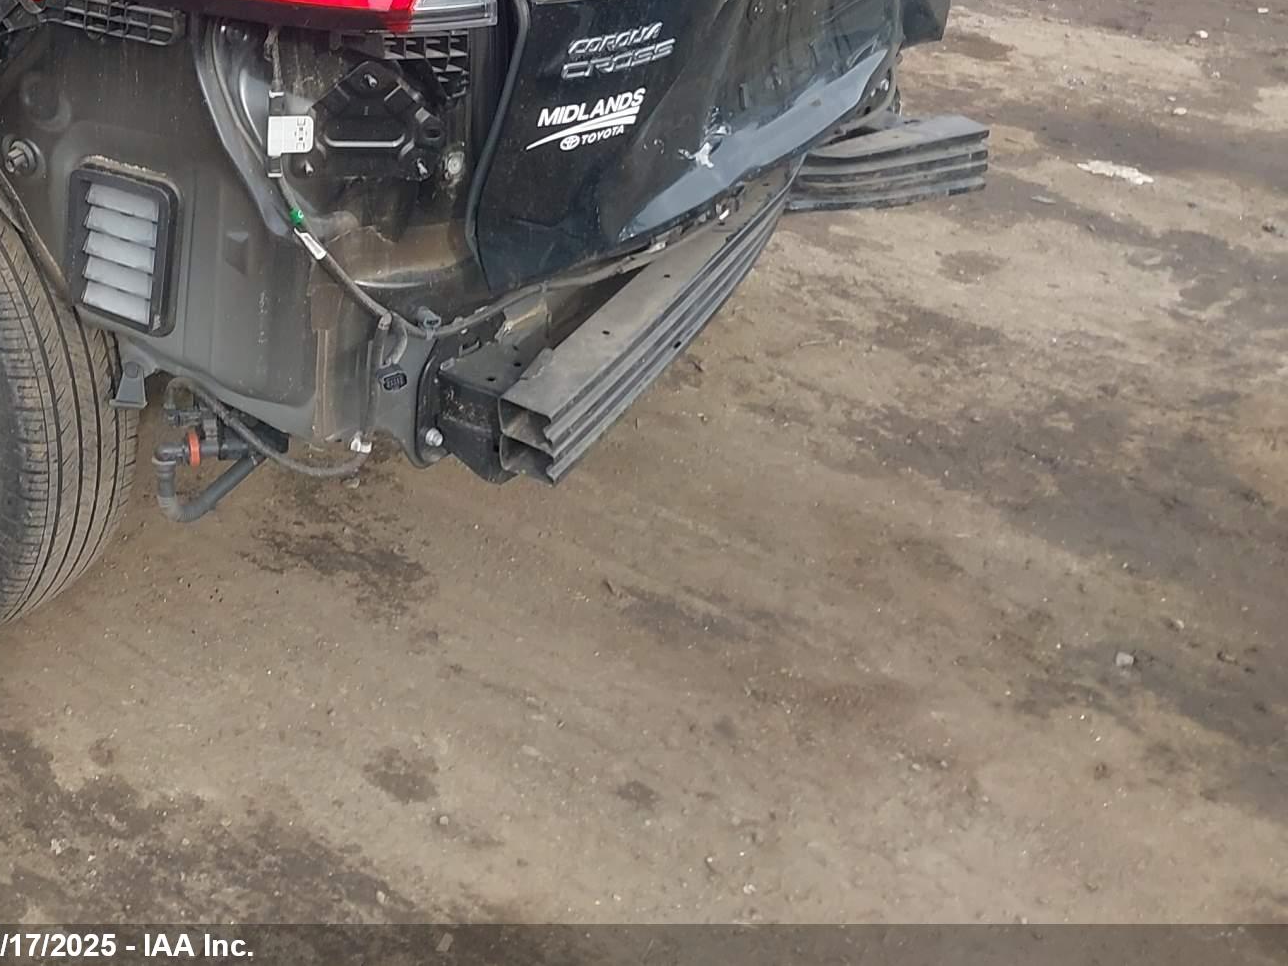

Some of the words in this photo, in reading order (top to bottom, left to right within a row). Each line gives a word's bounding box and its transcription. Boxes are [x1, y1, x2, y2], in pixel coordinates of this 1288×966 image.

[567, 22, 663, 55] COROLLA
[562, 38, 676, 80] CROSS
[537, 87, 646, 127] MIDLANDS
[581, 124, 625, 146] TOYOTA
